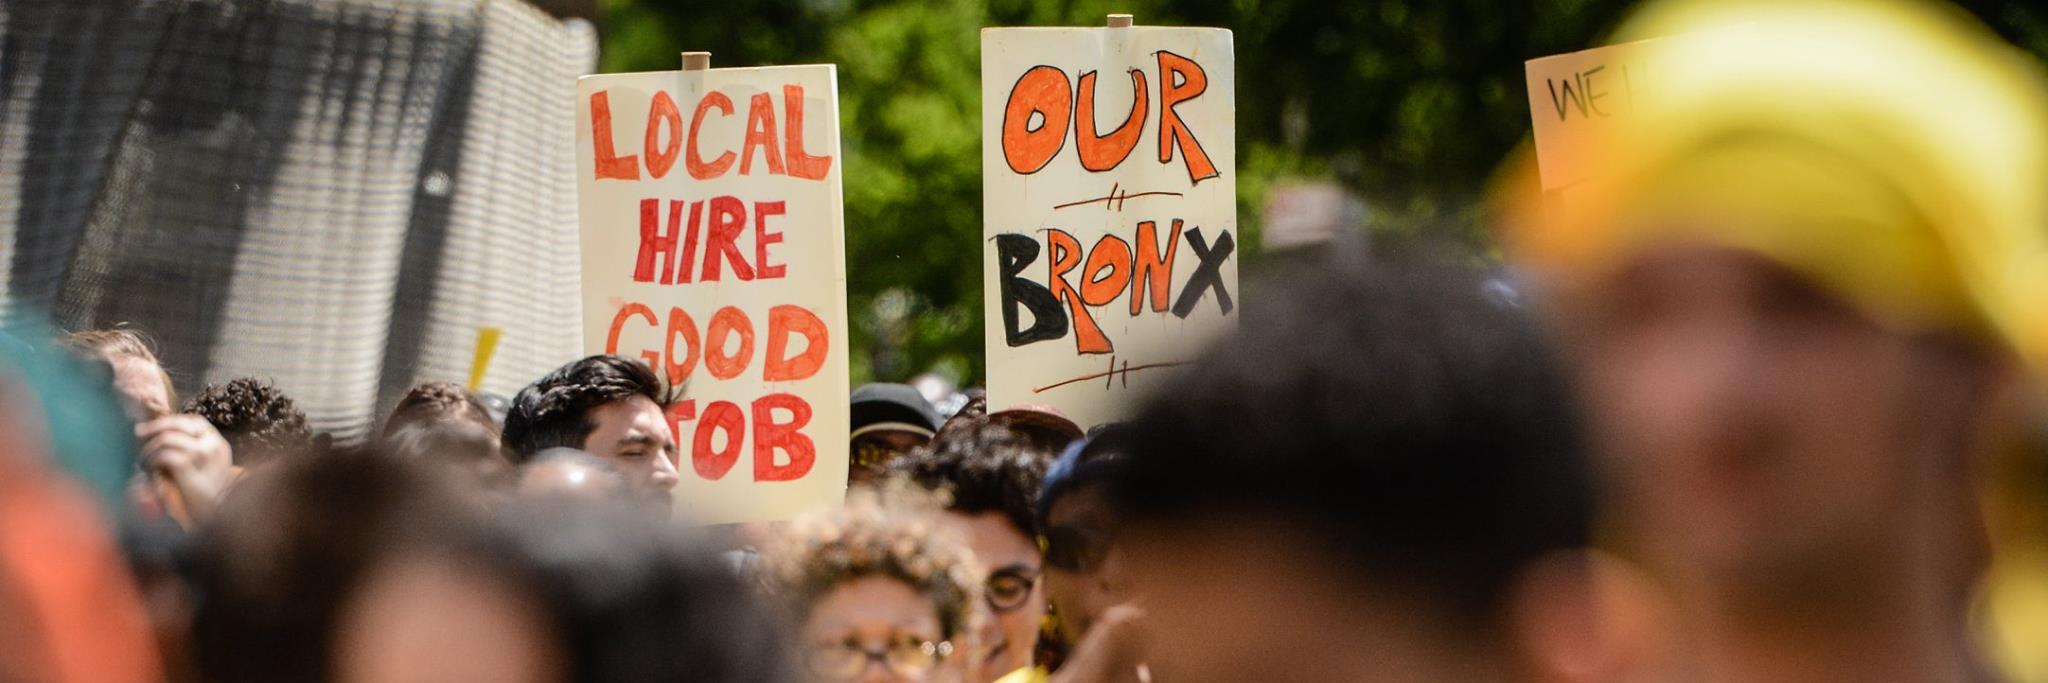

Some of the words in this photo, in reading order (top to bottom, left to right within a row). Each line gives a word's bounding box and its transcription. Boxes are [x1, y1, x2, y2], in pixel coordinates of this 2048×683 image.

[590, 84, 832, 181] LOCAL
[1002, 50, 1221, 186] OUR
[1547, 65, 1611, 122] WE
[633, 195, 787, 285] HIRE
[993, 218, 1235, 355] BRONX
[605, 302, 829, 386] GOOD
